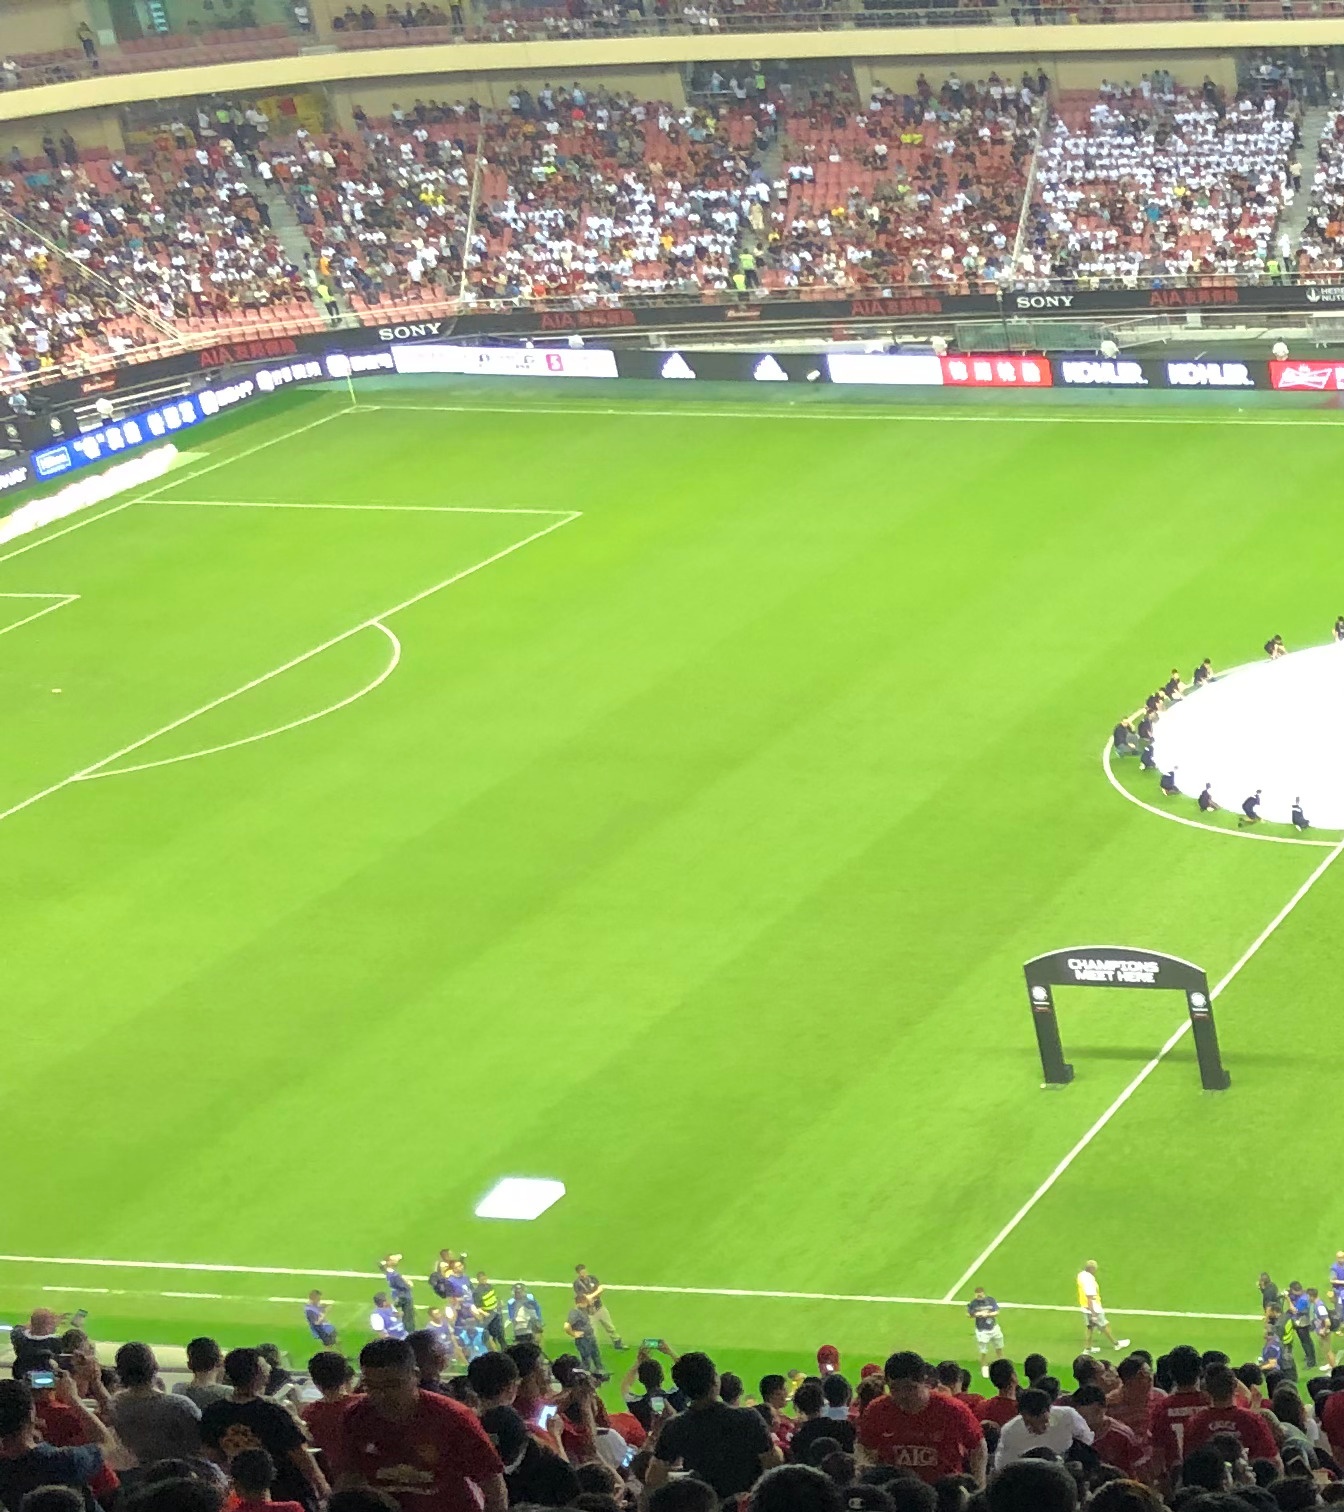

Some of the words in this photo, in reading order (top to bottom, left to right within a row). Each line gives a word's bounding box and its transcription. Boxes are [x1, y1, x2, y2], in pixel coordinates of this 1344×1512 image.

[1016, 296, 1073, 309] SONY
[378, 322, 442, 341] SONY
[1067, 958, 1160, 973] CHAMPIONS
[1074, 969, 1115, 982] MEET
[1116, 971, 1156, 983] HERE
